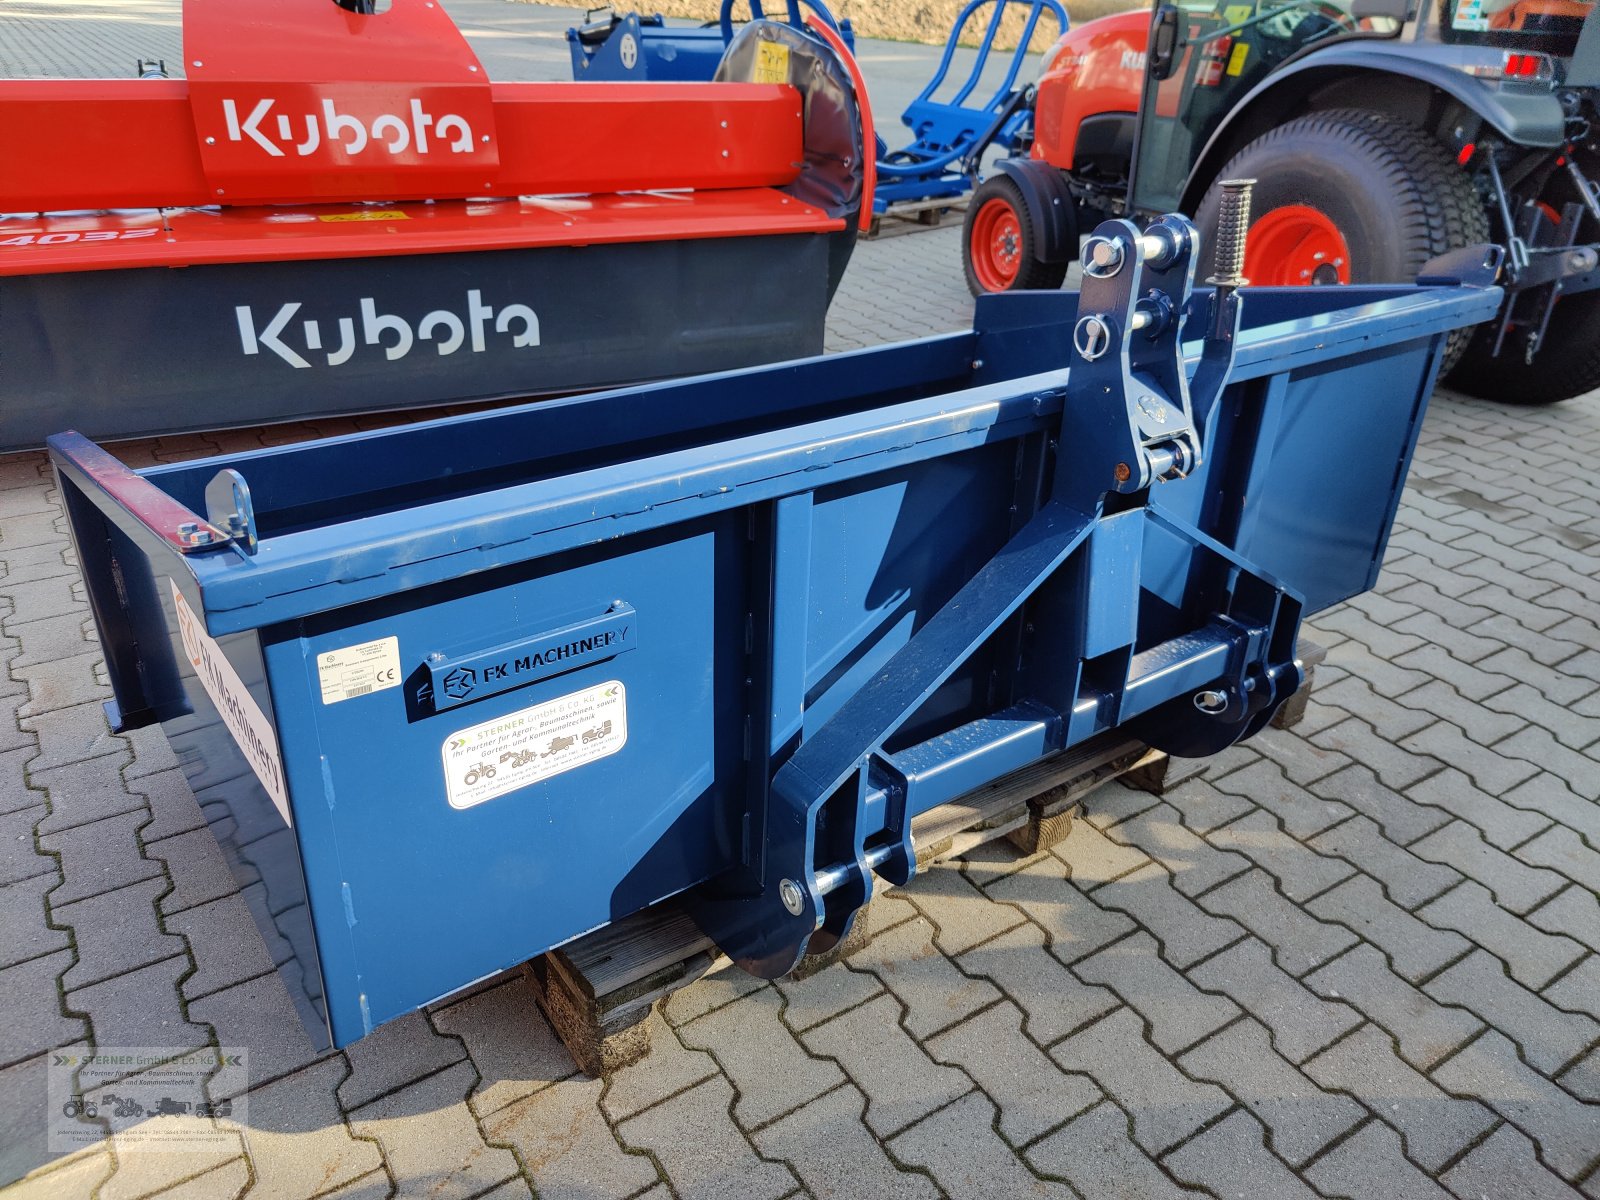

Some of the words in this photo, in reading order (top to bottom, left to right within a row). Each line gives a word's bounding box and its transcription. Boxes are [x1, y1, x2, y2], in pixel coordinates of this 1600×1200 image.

[222, 98, 474, 157] Kubota
[0, 228, 159, 246] 4032
[235, 289, 541, 368] Kubota
[484, 662, 509, 683] FK
[515, 626, 629, 673] MACHINERY
[214, 664, 280, 795] Machinery
[452, 749, 465, 759] Ihr
[466, 738, 497, 754] Partner
[596, 697, 617, 709] sowie
[477, 718, 525, 741] STERNER
[528, 707, 557, 723] GmbH
[583, 695, 595, 703] KG
[481, 743, 511, 758] Garten-
[512, 736, 527, 746] und
[529, 713, 596, 740] Kommunaltechnik
